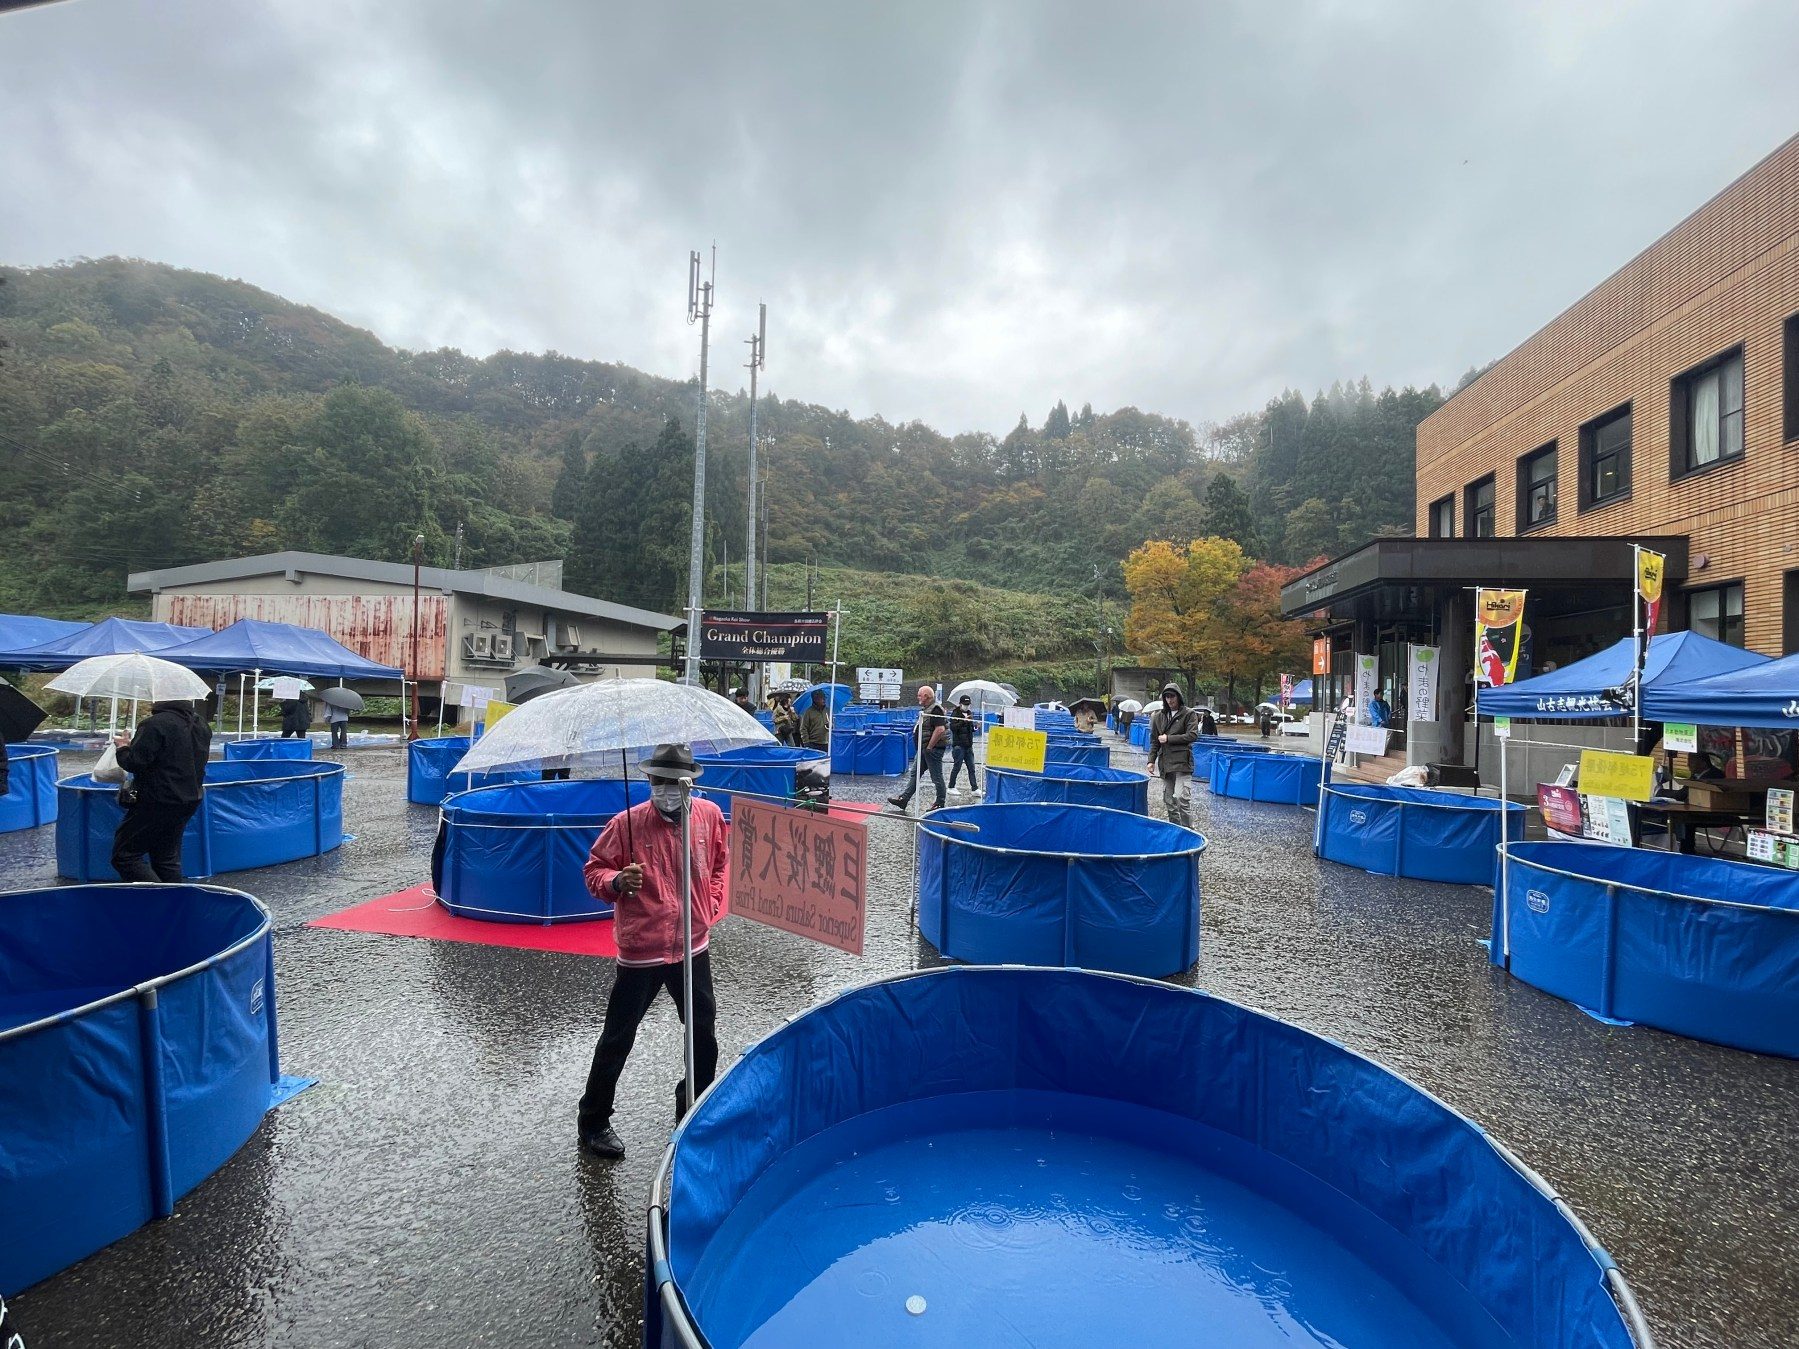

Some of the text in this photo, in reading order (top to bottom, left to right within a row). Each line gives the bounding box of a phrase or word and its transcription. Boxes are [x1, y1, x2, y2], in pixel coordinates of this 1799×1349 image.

[1486, 601, 1511, 610] Hikari
[707, 629, 822, 648] Grand Champion
